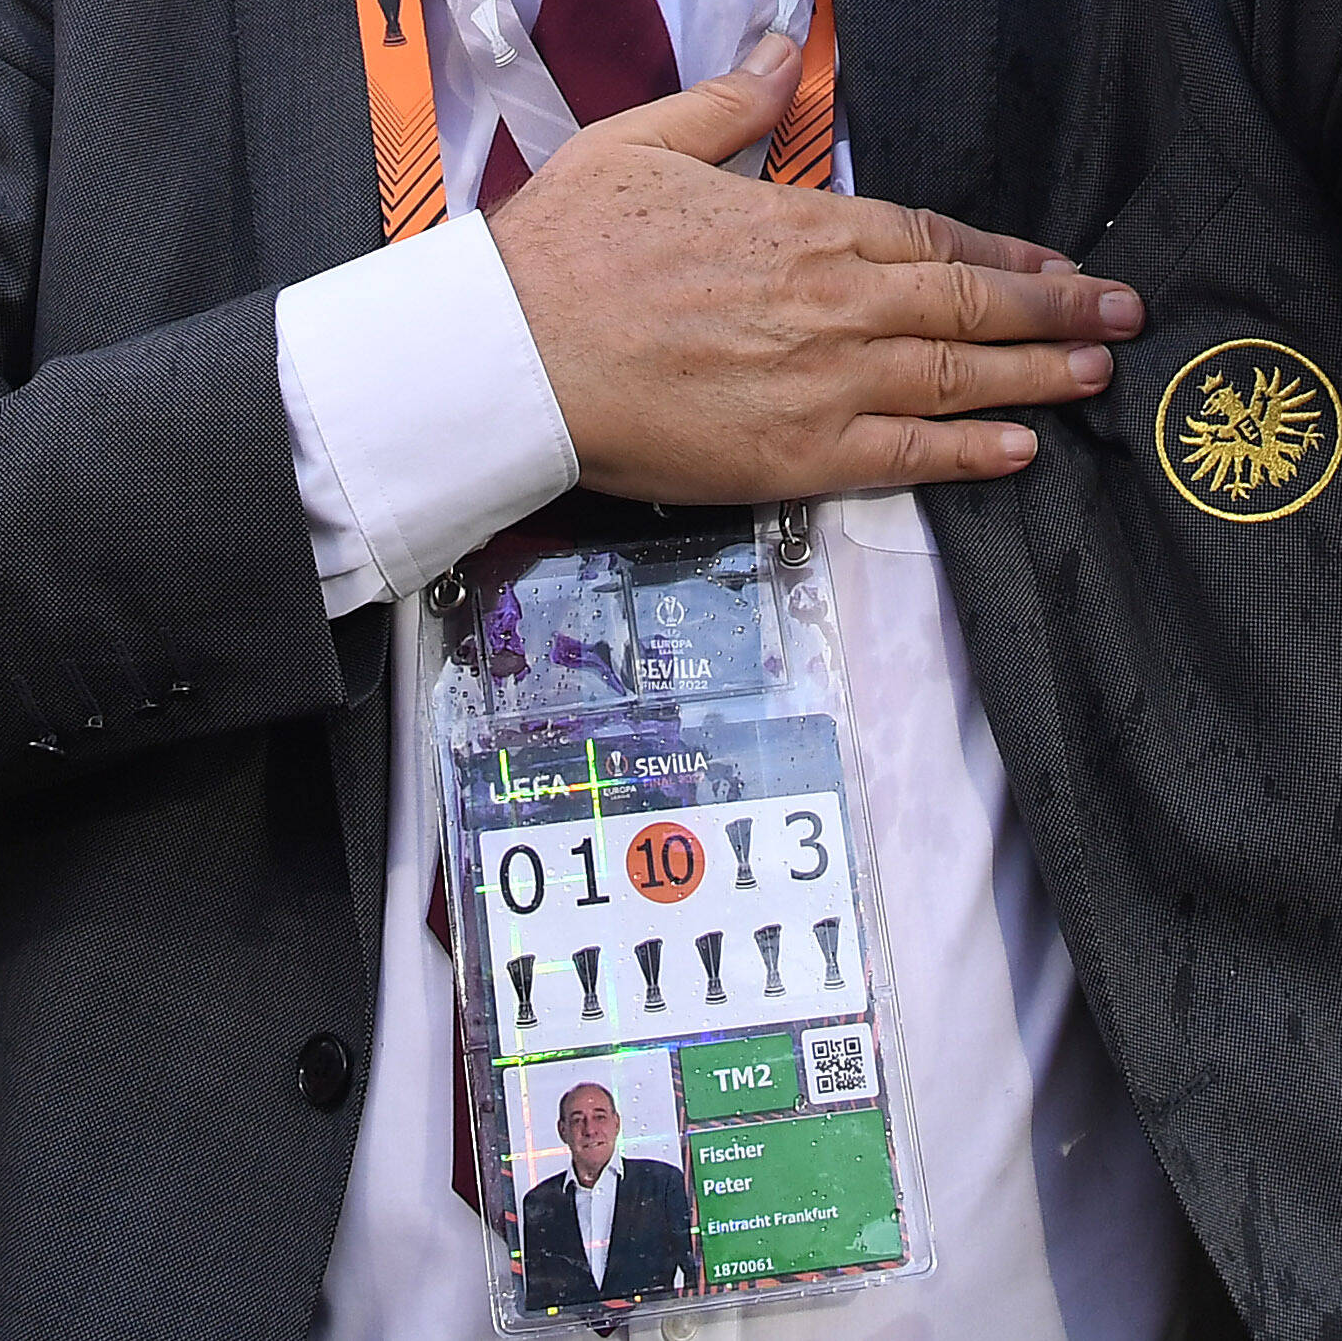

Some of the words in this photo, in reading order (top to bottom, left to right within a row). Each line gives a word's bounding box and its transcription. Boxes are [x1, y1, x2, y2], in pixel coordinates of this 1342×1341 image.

[642, 680, 675, 690] FINAL
[679, 680, 708, 690] 2022
[489, 773, 570, 805] UEFA
[636, 834, 694, 888] 10
[785, 810, 829, 882] 3
[712, 1064, 773, 1092] TM2
[699, 1143, 765, 1164] Fischer
[703, 1177, 753, 1196] Peter
[708, 1215, 771, 1235] Eintracht
[774, 1206, 839, 1226] Frankfurt
[713, 1258, 774, 1278] 1870061
